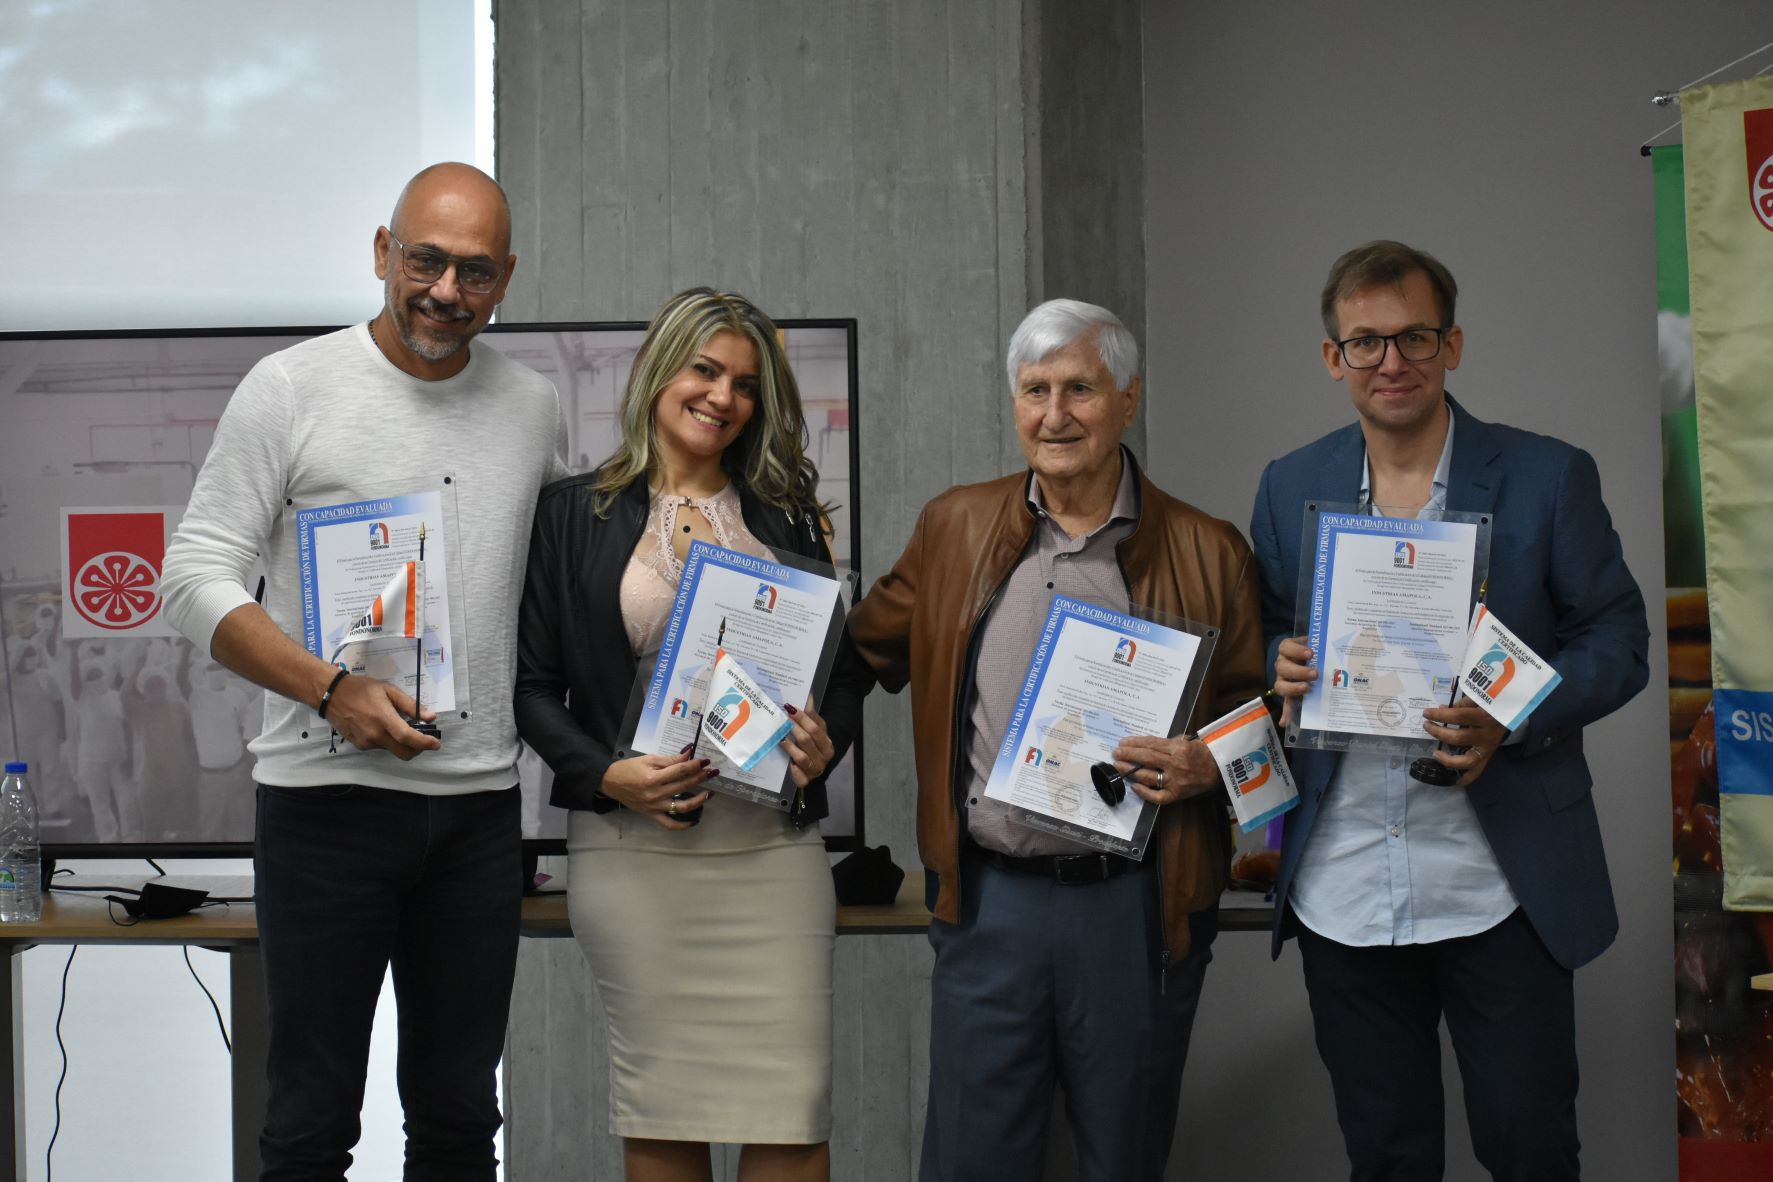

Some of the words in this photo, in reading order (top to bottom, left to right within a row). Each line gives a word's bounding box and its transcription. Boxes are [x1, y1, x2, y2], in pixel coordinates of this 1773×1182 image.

[299, 512, 314, 521] CON
[315, 506, 354, 519] CAPACIDAD
[354, 500, 393, 514] EVALUADA
[1322, 515, 1338, 524] CON
[1339, 516, 1382, 528] CAPACIDAD
[1383, 520, 1424, 532] EVALUADA
[299, 521, 309, 549] FIRMAS
[1319, 523, 1330, 551] FIRMAS
[301, 549, 310, 560] DE
[692, 543, 709, 554] CON
[709, 548, 751, 567] CAPACIDAD
[751, 560, 790, 579] EVALUADA
[1319, 552, 1327, 562] DE
[687, 552, 699, 579] FIRMAS
[301, 561, 314, 618] CERTIFICACIÓN
[682, 579, 691, 590] DE
[1313, 563, 1327, 620] CERTIFICACIÓN
[306, 620, 314, 630] LA
[352, 614, 372, 630] 001
[666, 589, 688, 646] CERTIFICACIÓN
[1047, 606, 1062, 633] FIRMAS
[1055, 598, 1072, 609] CON
[1071, 603, 1113, 622] CAPACIDAD
[1112, 614, 1151, 633] EVALUADA
[1312, 621, 1320, 631] LA
[307, 631, 316, 650] PARA
[1042, 631, 1052, 643] DE
[1310, 632, 1320, 651] PARA
[1490, 625, 1510, 642] SISTEMA
[1515, 646, 1522, 654] LA
[1522, 652, 1542, 670] CALIDAD
[662, 646, 672, 657] LA
[1498, 638, 1527, 665] CERTIFICADO
[656, 658, 668, 677] PARA
[727, 669, 745, 686] SISTEMA
[1024, 642, 1048, 697] CERTIFICACIÓN
[1478, 661, 1493, 674] ISO
[1468, 668, 1492, 691] 9001
[648, 679, 662, 708] SISTEMA
[1018, 696, 1029, 707] LA
[1464, 679, 1492, 705] FONDONORMA
[714, 704, 728, 717] ISO
[1012, 706, 1025, 726] PARA
[706, 711, 728, 733] 9001
[1732, 709, 1773, 742] SIS
[1003, 727, 1018, 757] SISTEMA
[1232, 758, 1248, 784] 9001
[1243, 757, 1253, 771] ISO
